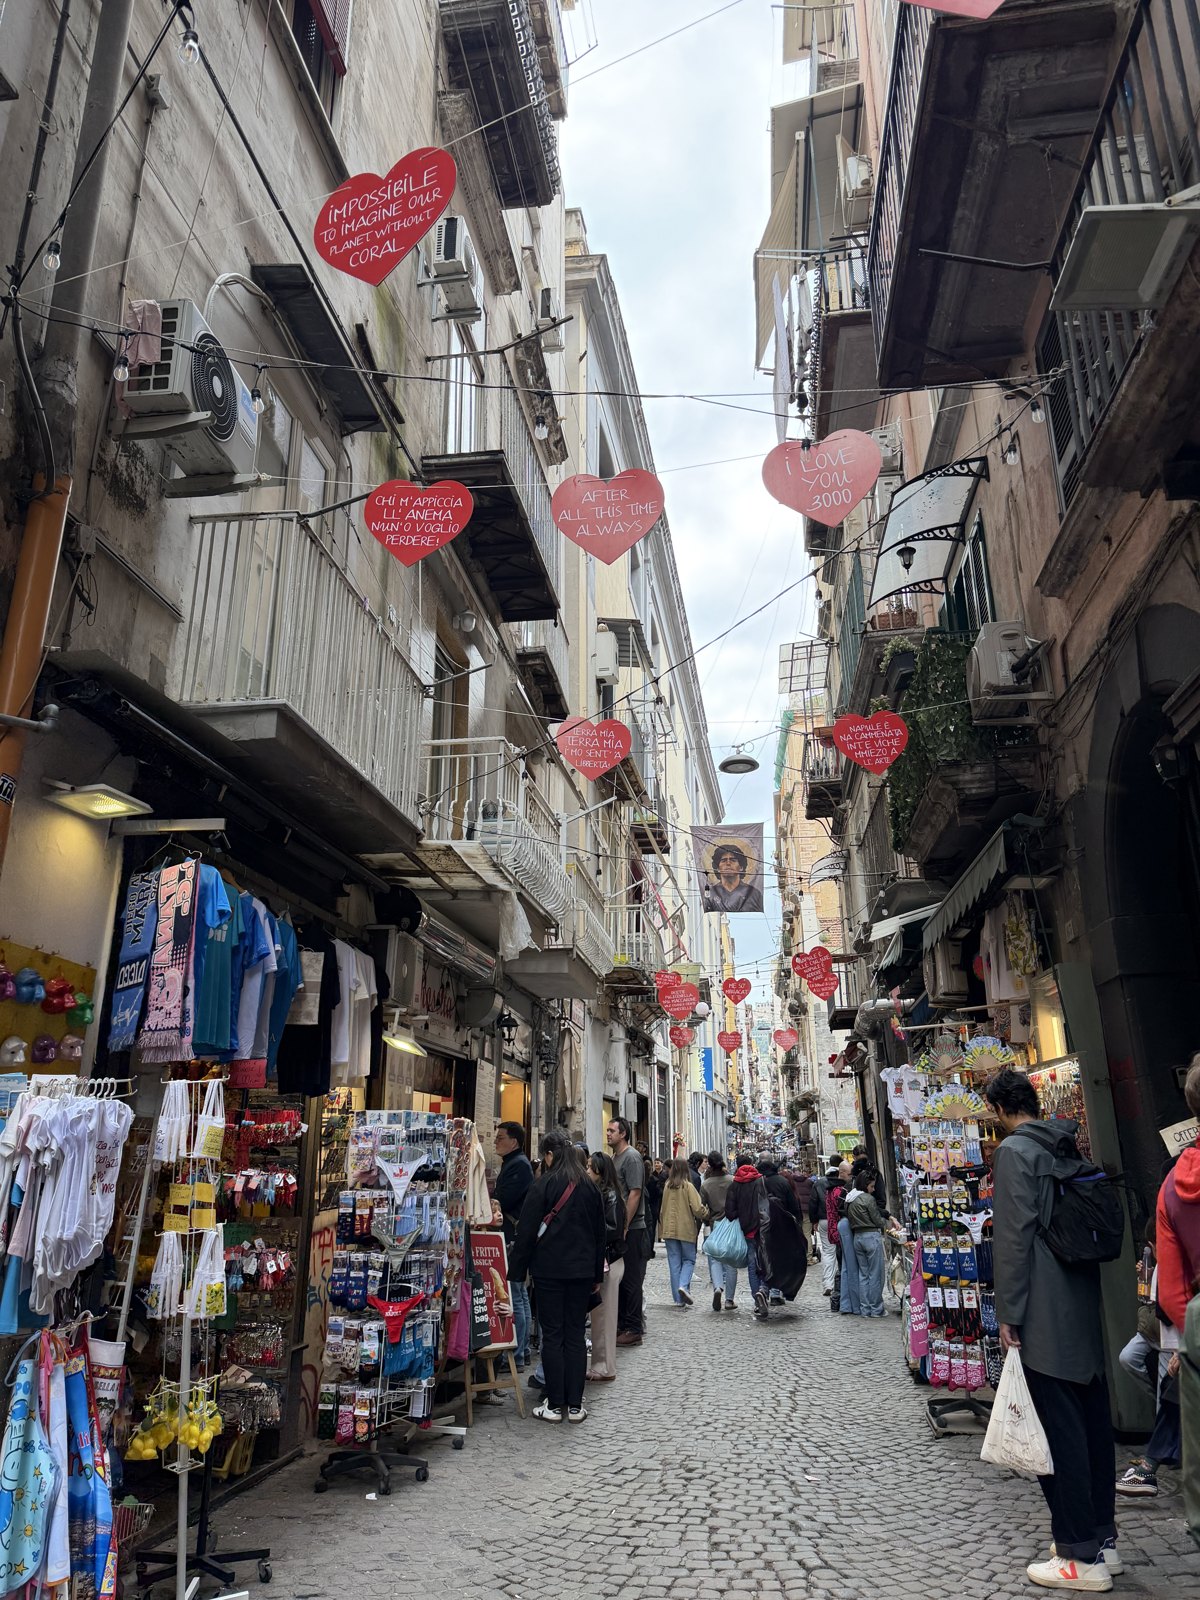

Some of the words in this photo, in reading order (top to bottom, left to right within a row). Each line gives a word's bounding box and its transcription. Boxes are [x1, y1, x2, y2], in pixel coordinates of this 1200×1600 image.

[320, 228, 336, 243] TO
[341, 201, 402, 236] IMAGINE
[408, 187, 443, 209] OUR
[329, 231, 373, 256] PLANET
[375, 208, 435, 239] WITHOUT
[349, 238, 405, 267] CORAL
[800, 446, 856, 473] LOVE
[801, 470, 853, 492] YOU
[582, 488, 630, 504] AFTER
[806, 488, 852, 512] 3000
[558, 509, 588, 522] ALL
[591, 503, 622, 519] THIS
[626, 500, 659, 515] TIME
[416, 521, 460, 534] VOGLIO
[576, 519, 643, 538] ALWAYS
[565, 735, 599, 747] TERRA
[603, 738, 623, 749] MIA
[573, 727, 597, 737] TERRA
[125, 892, 140, 935] DIEGO
[476, 1246, 500, 1257] FRITTA
[475, 1314, 489, 1324] bag
